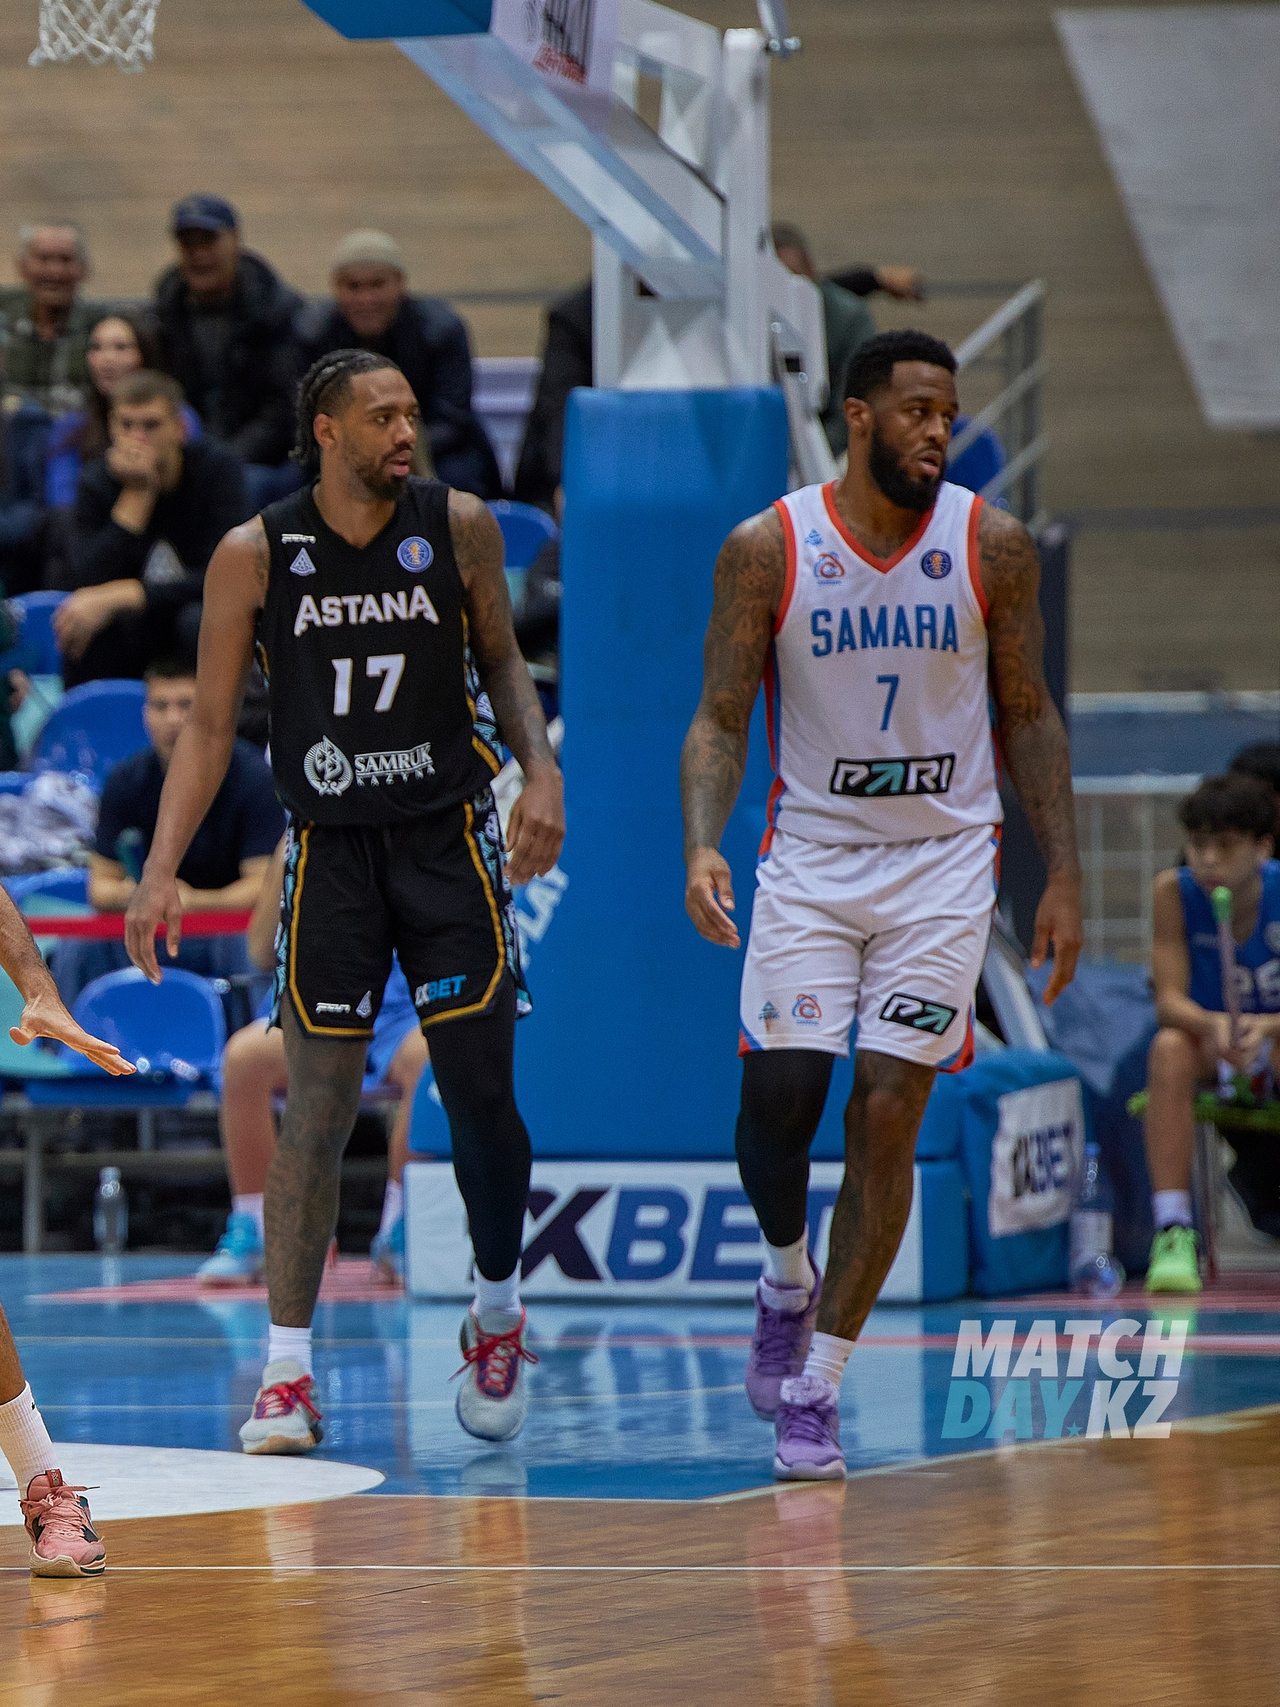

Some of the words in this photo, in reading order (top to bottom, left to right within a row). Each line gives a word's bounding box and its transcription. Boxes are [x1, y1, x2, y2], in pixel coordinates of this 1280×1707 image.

[294, 585, 440, 637] ASTANA
[811, 604, 959, 657] SAMARA
[331, 653, 406, 716] 17
[876, 673, 900, 731] 7
[354, 742, 432, 774] SAMRUK
